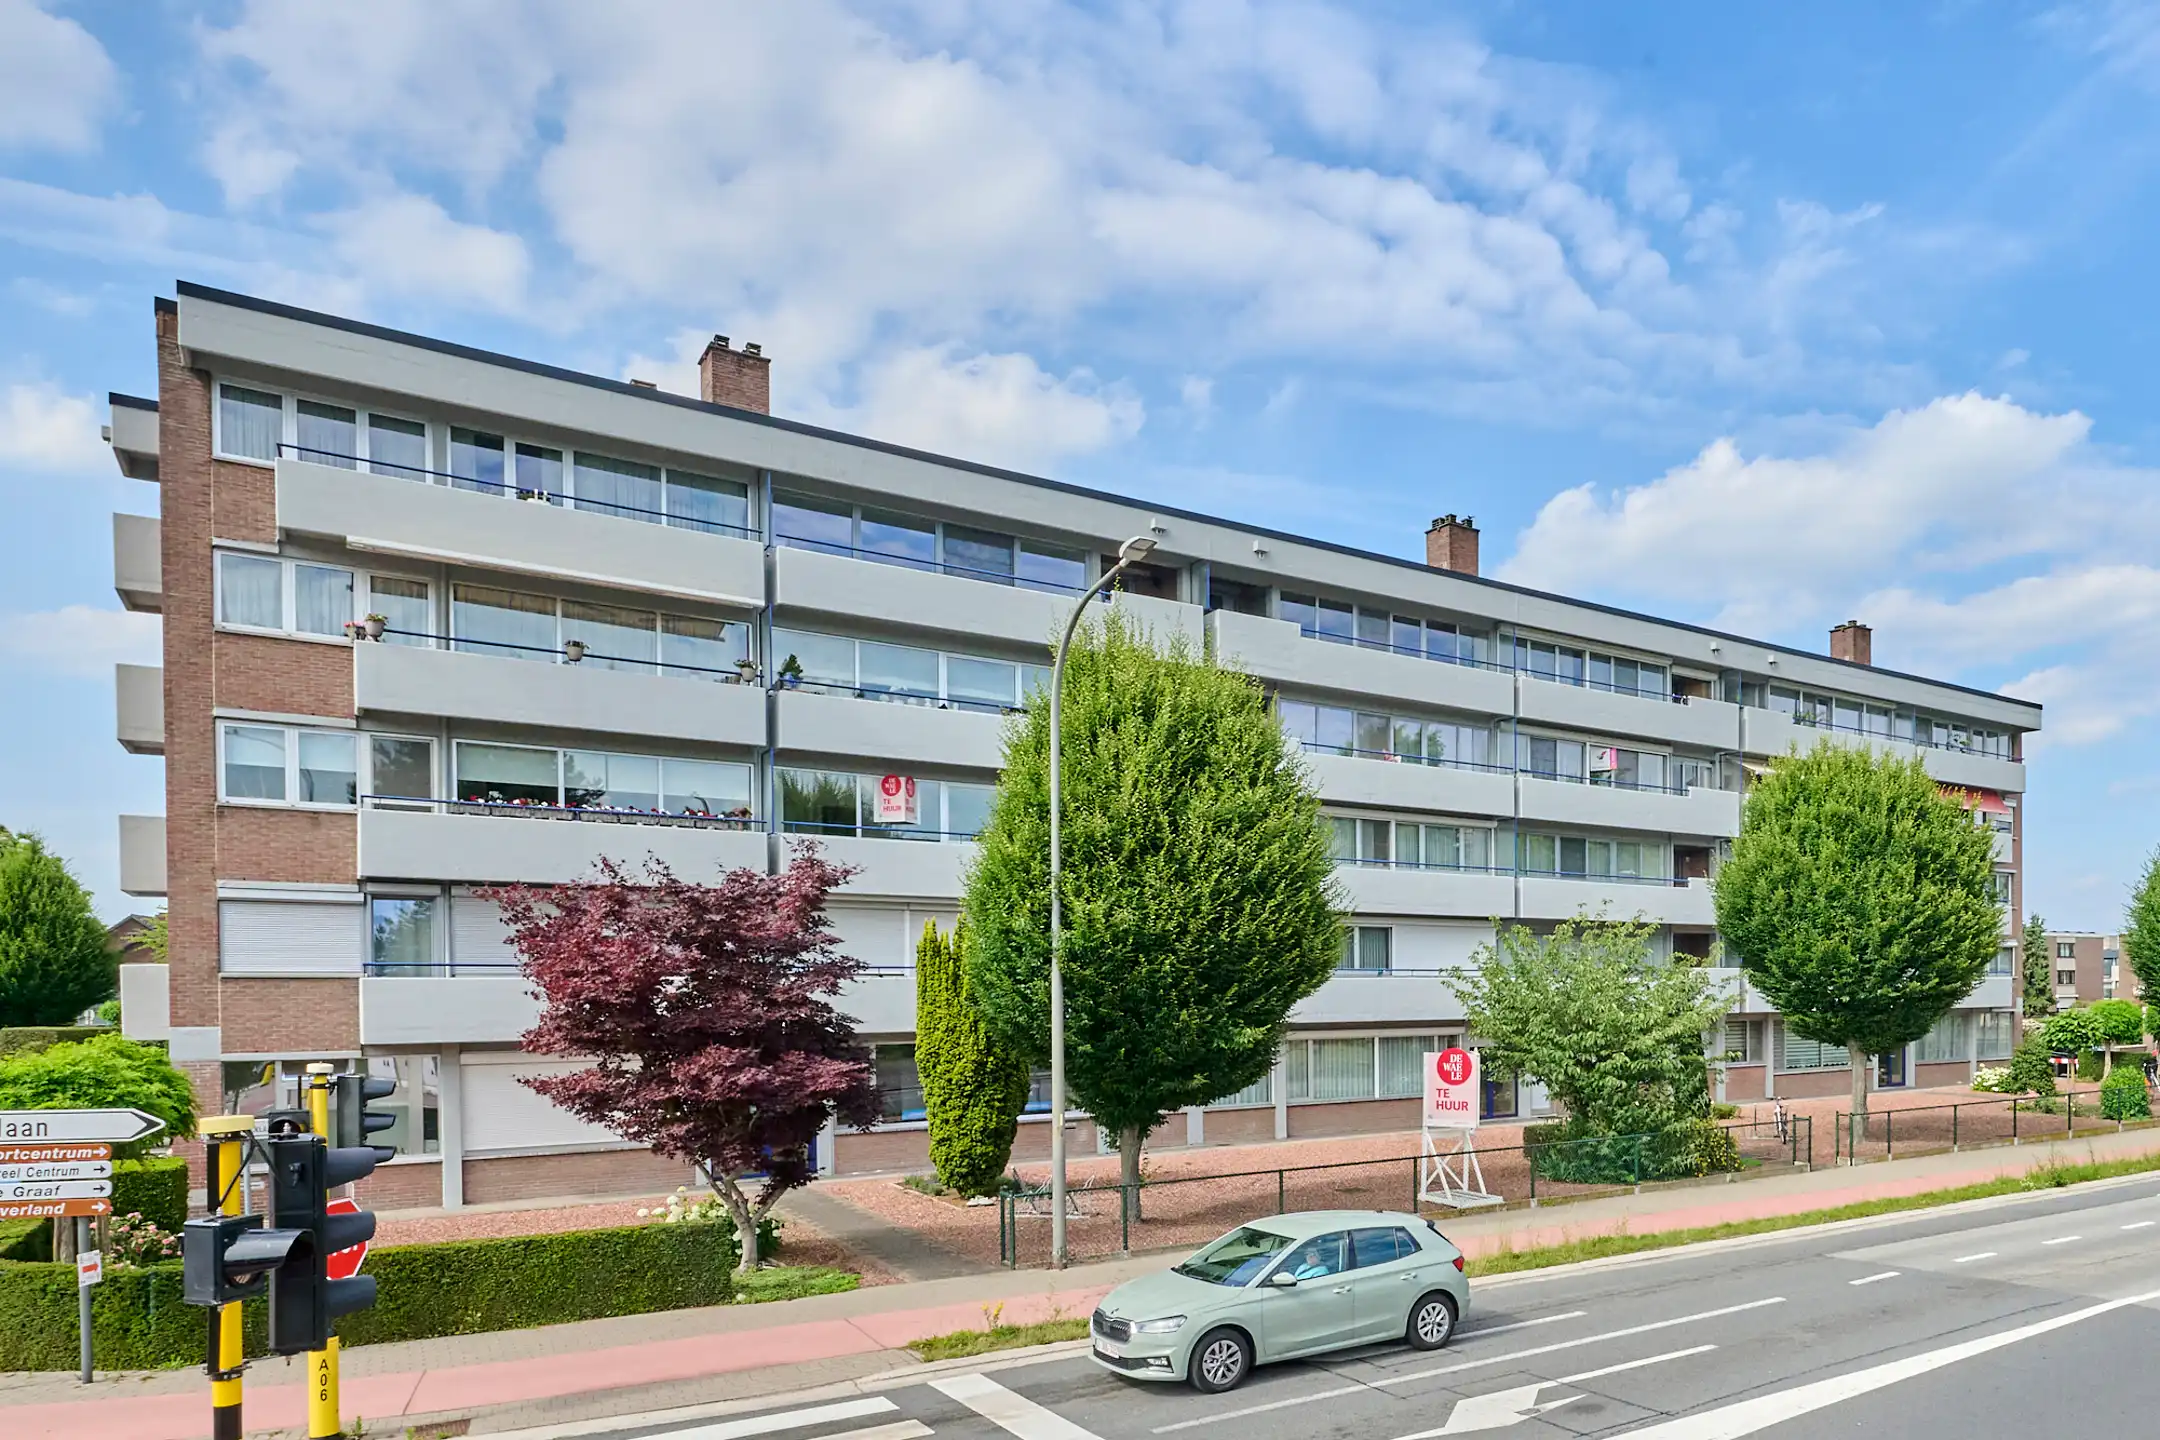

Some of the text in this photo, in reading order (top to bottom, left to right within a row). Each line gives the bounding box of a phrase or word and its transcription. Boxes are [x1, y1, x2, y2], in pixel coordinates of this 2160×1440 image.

[1449, 1053, 1463, 1063] DE
[1442, 1062, 1463, 1072] WAE
[1451, 1071, 1463, 1081] LE
[1436, 1088, 1450, 1099] TE
[1436, 1100, 1469, 1111] HUUR
[26, 1166, 80, 1178] Centrum
[13, 1184, 62, 1198] Graaf
[0, 1202, 66, 1217] verland
